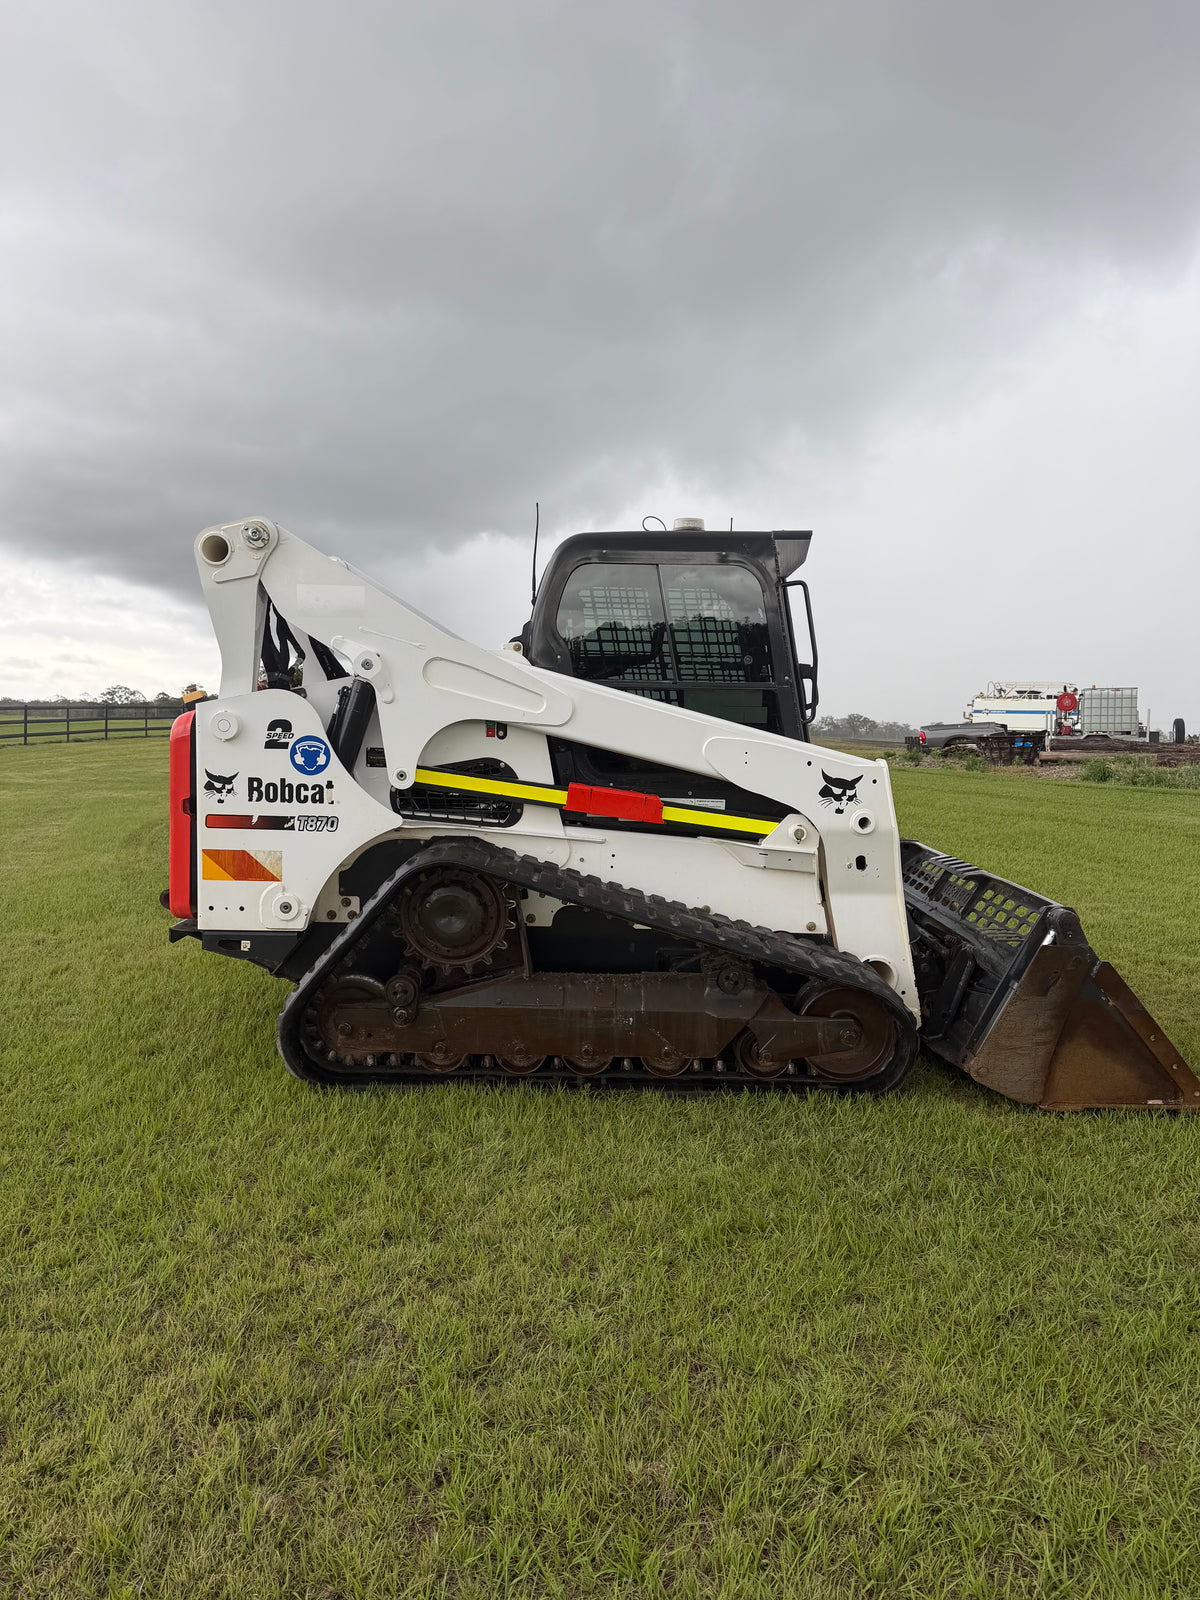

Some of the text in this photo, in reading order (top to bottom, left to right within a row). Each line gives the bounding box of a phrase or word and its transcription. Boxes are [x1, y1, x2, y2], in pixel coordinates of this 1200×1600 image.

[264, 719, 293, 749] 2
[266, 732, 295, 740] SPEED
[297, 815, 339, 832] T870
